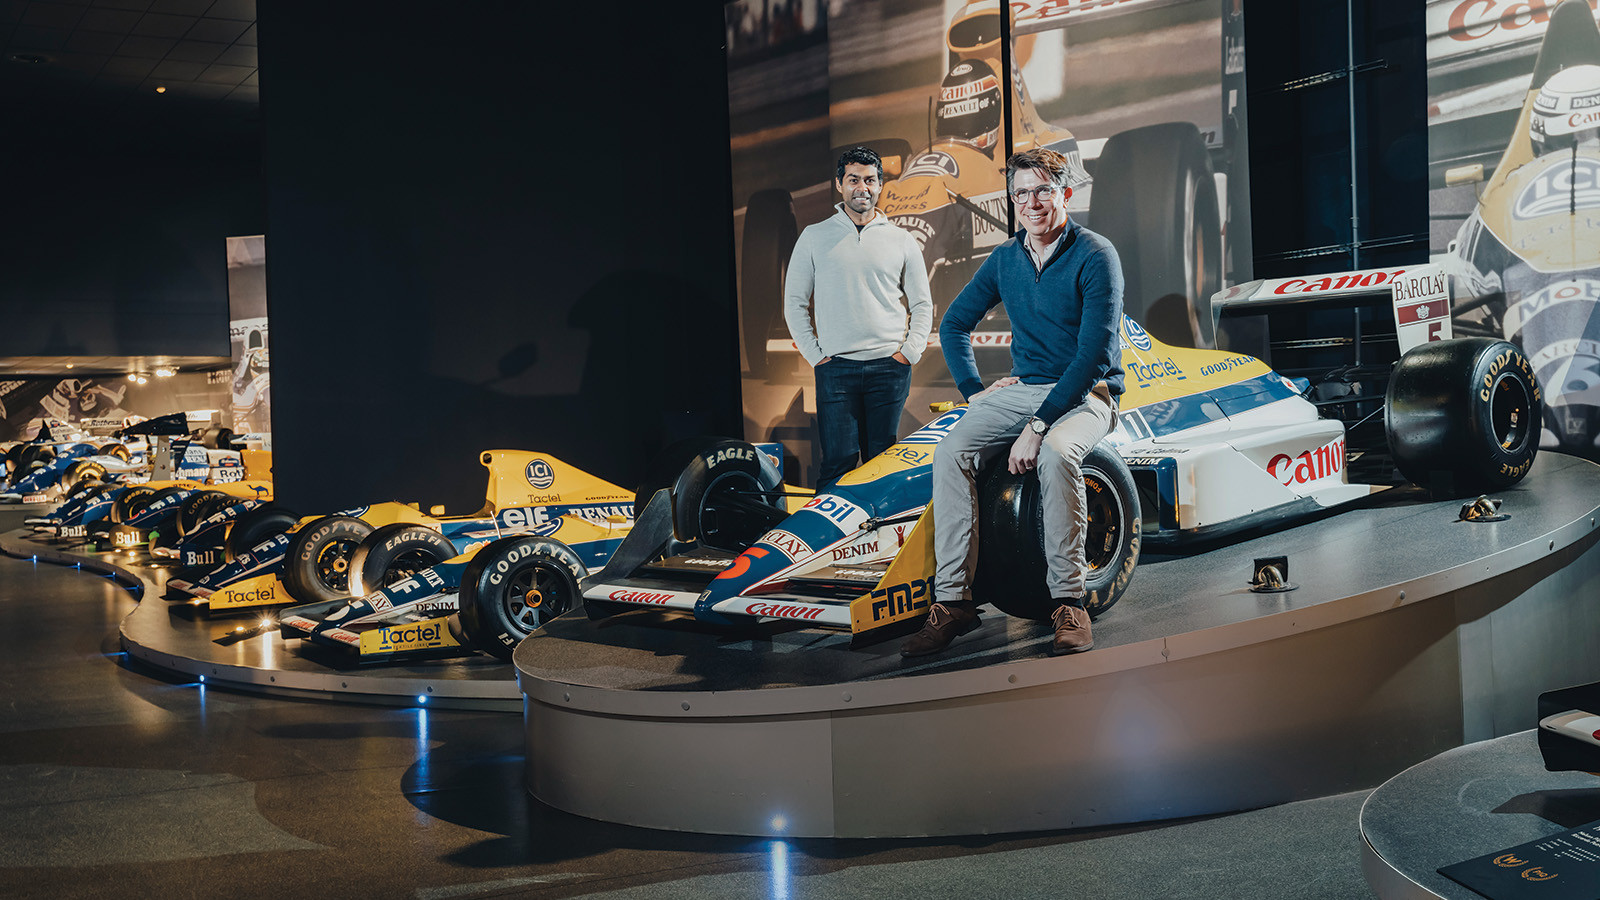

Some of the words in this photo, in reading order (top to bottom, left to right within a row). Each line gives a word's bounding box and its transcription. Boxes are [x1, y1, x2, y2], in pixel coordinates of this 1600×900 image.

[941, 81, 983, 101] Canon
[945, 102, 977, 115] RENAULT
[1572, 95, 1600, 109] DEN
[886, 185, 931, 202] World
[884, 201, 928, 214] Class
[975, 195, 1008, 236] BOUTS
[889, 216, 936, 239] NAULT
[1395, 273, 1446, 302] BARCLAY
[1428, 321, 1443, 342] 5
[1127, 357, 1183, 382] Tactel
[1200, 355, 1257, 377] GOODYEAR
[1480, 349, 1541, 402] GOODYEAR
[706, 447, 755, 470] EAGLE
[530, 465, 549, 477] ICI
[527, 494, 562, 504] Tactel
[503, 506, 550, 528] elf
[568, 505, 634, 523] RENAU
[803, 496, 856, 523] obil
[115, 531, 141, 545] Bull
[301, 520, 369, 561] GOODYE
[385, 531, 426, 551] EAGLE
[763, 531, 808, 558] CLAY
[186, 550, 215, 566] Bull
[832, 541, 880, 561] DENIM
[225, 587, 276, 603] Tactel
[609, 589, 675, 605] Canon
[415, 602, 455, 611] DENIM
[745, 602, 826, 620] Canon
[378, 623, 442, 645] Tactel
